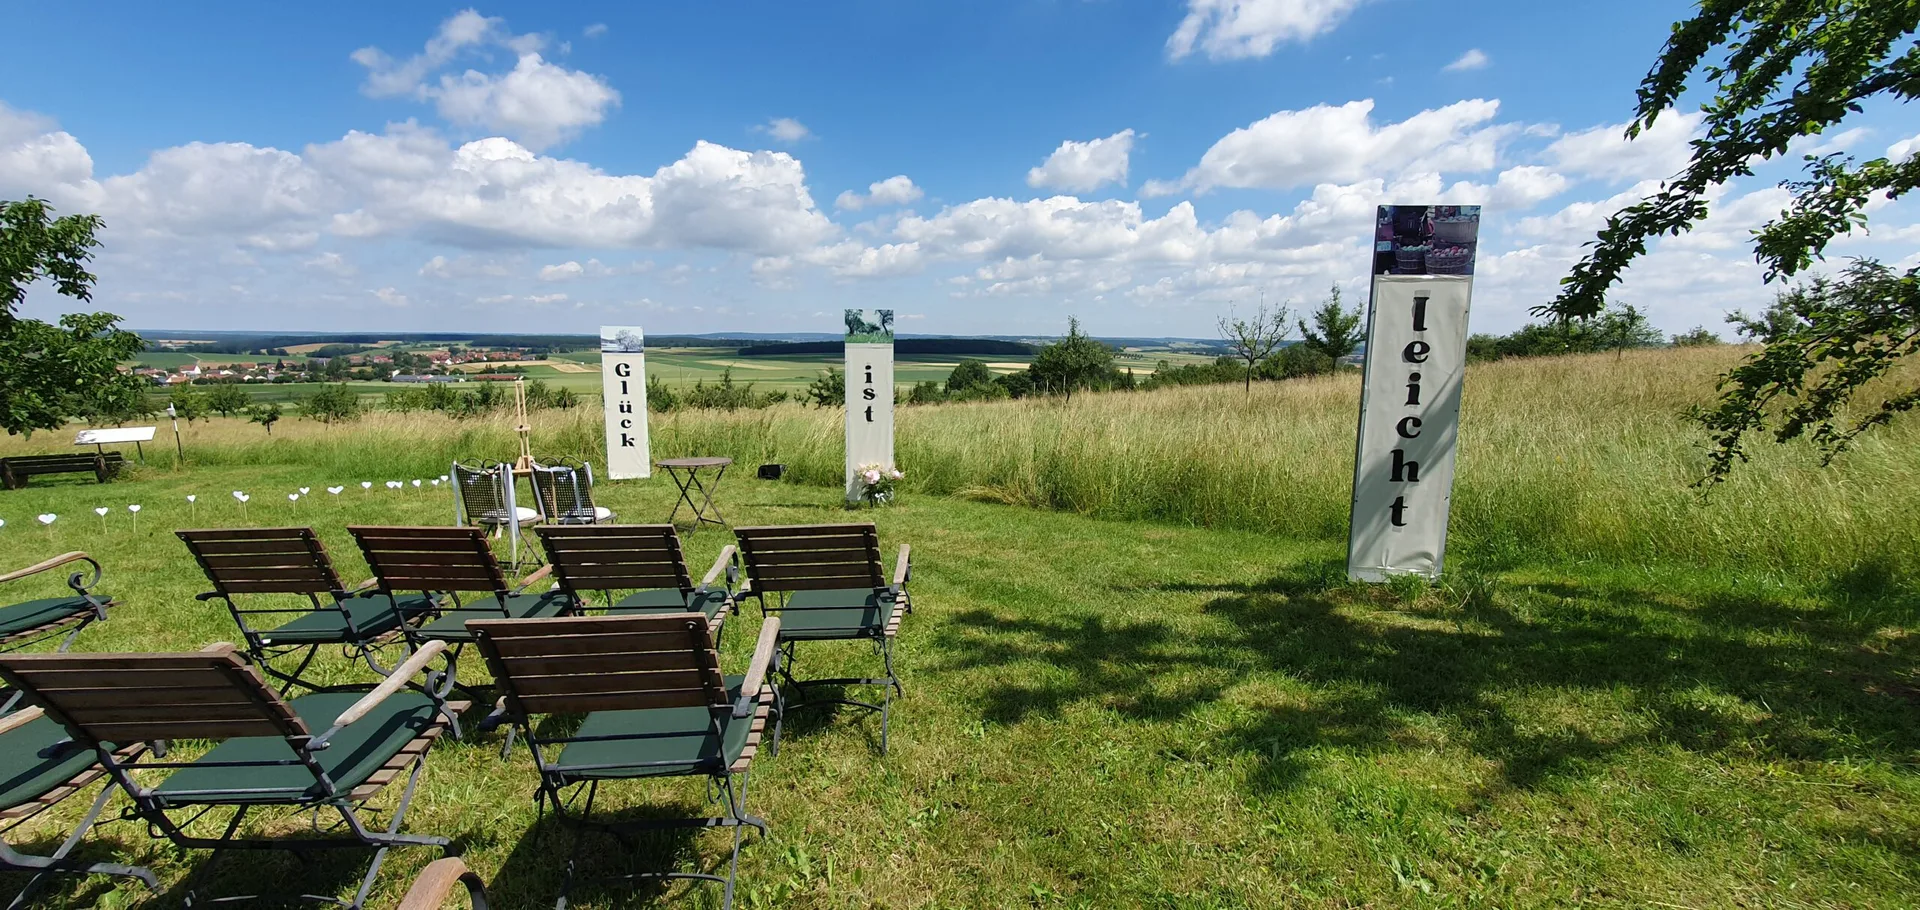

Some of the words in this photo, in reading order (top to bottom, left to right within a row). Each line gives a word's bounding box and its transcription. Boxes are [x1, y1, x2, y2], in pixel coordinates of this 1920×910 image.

[615, 363, 635, 447] Glück
[863, 365, 876, 422] ist
[1389, 296, 1431, 527] leicht
